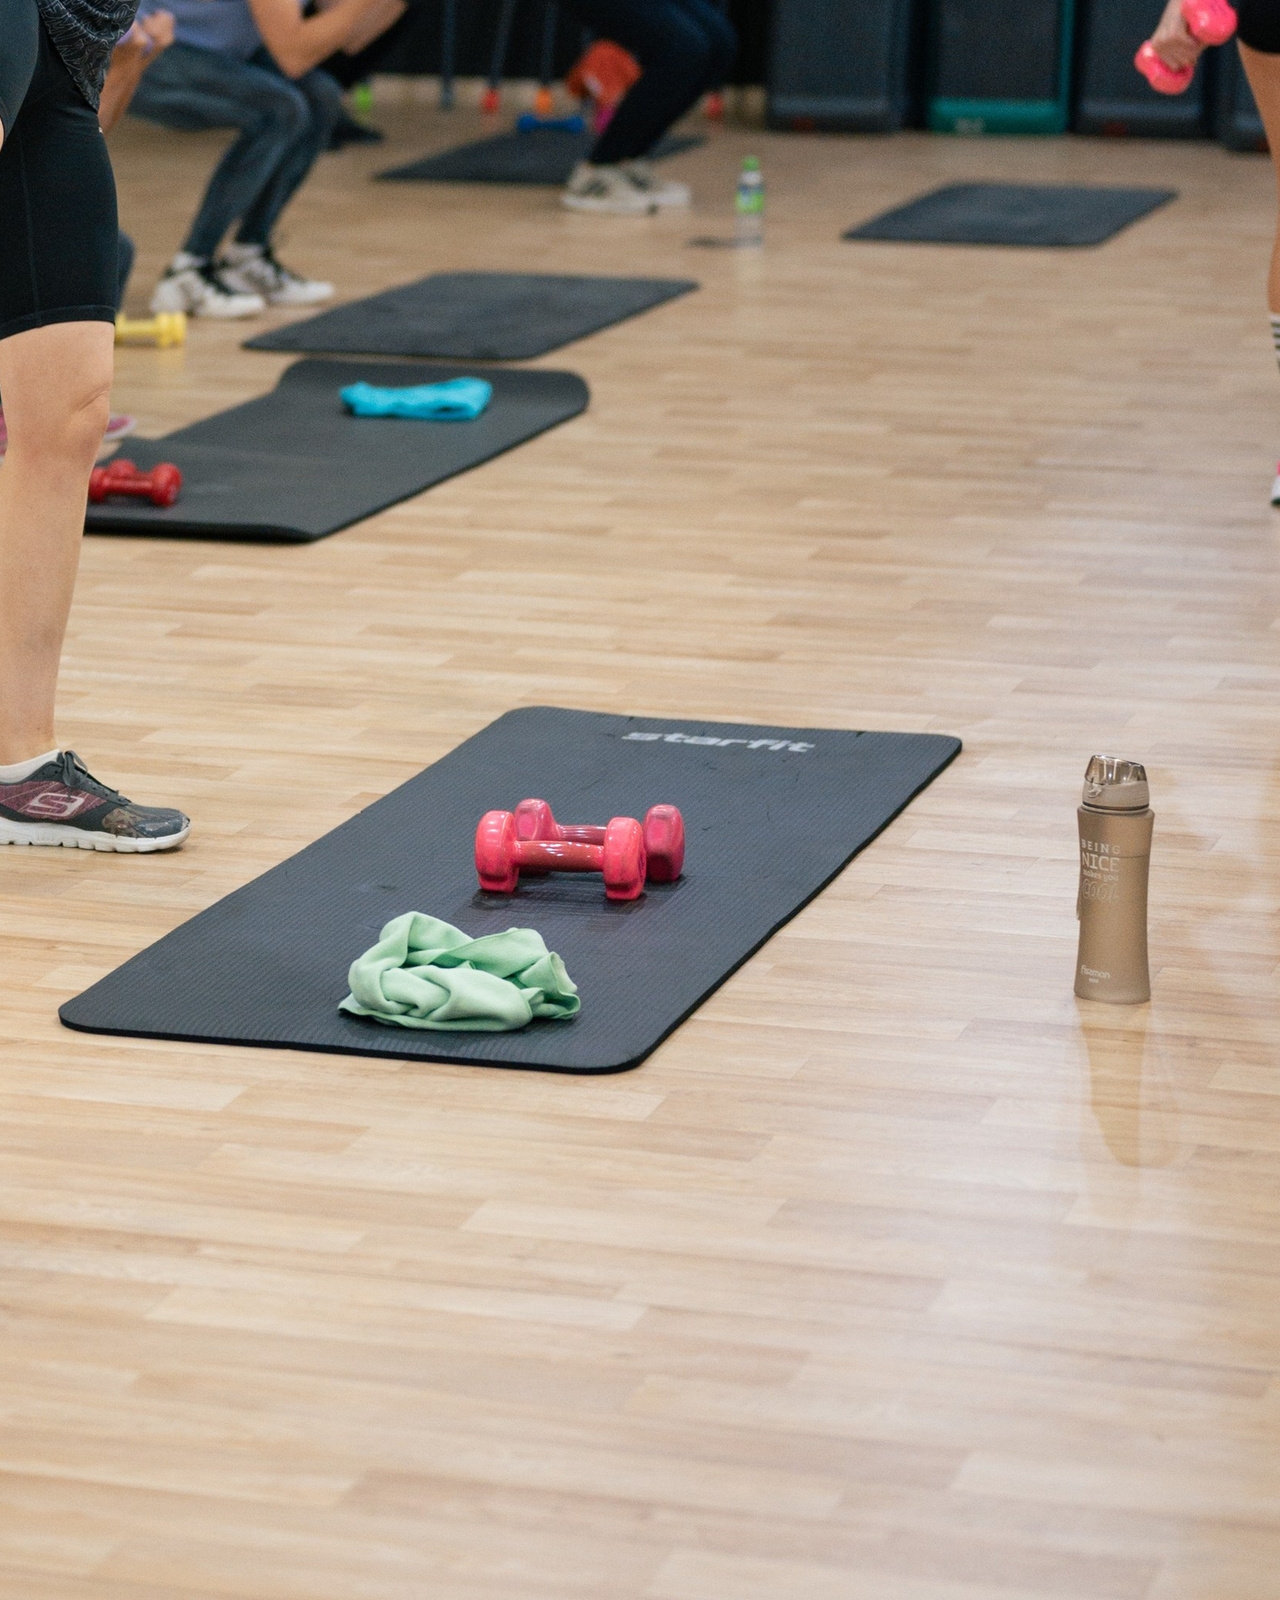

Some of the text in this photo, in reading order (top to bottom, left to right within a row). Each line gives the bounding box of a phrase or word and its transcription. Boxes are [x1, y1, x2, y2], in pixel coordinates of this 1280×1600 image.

[621, 731, 816, 753] starfit
[1081, 838, 1120, 855] BEING
[1081, 851, 1120, 872] NICE
